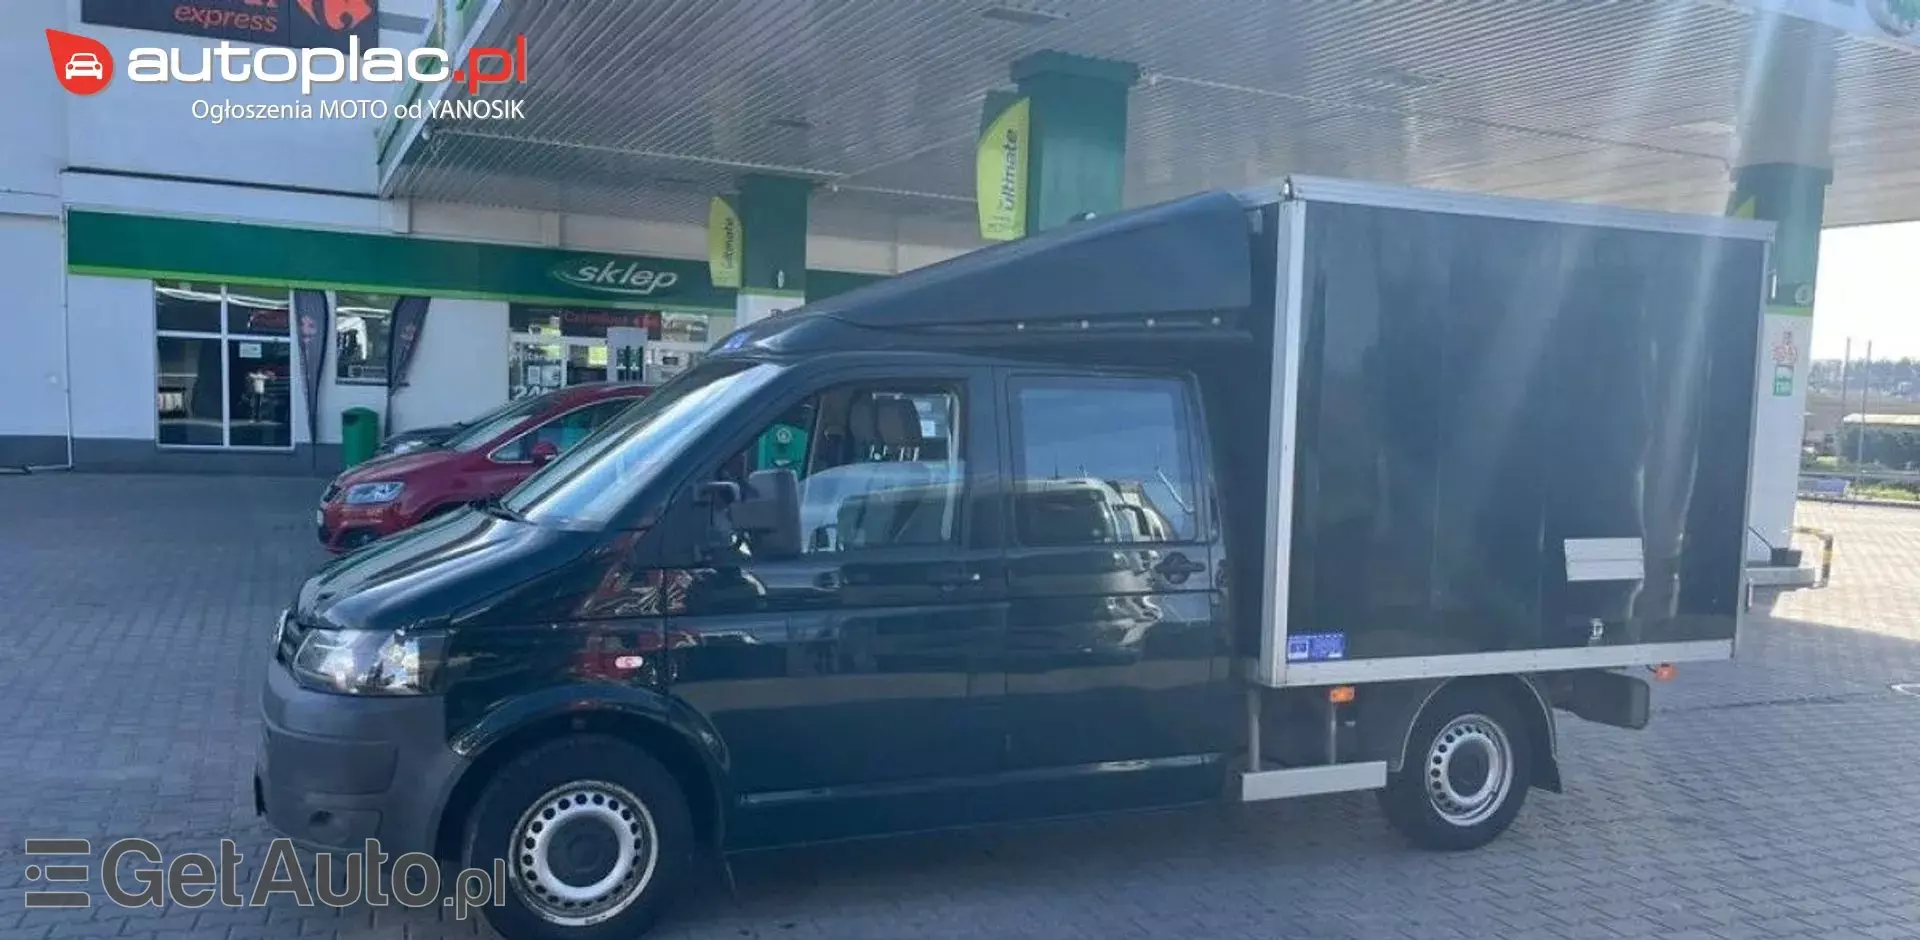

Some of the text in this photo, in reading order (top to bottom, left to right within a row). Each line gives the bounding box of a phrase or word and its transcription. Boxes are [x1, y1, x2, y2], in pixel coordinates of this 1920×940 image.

[174, 5, 278, 32] express
[1002, 127, 1019, 212] ultimate
[577, 260, 679, 295] sklep
